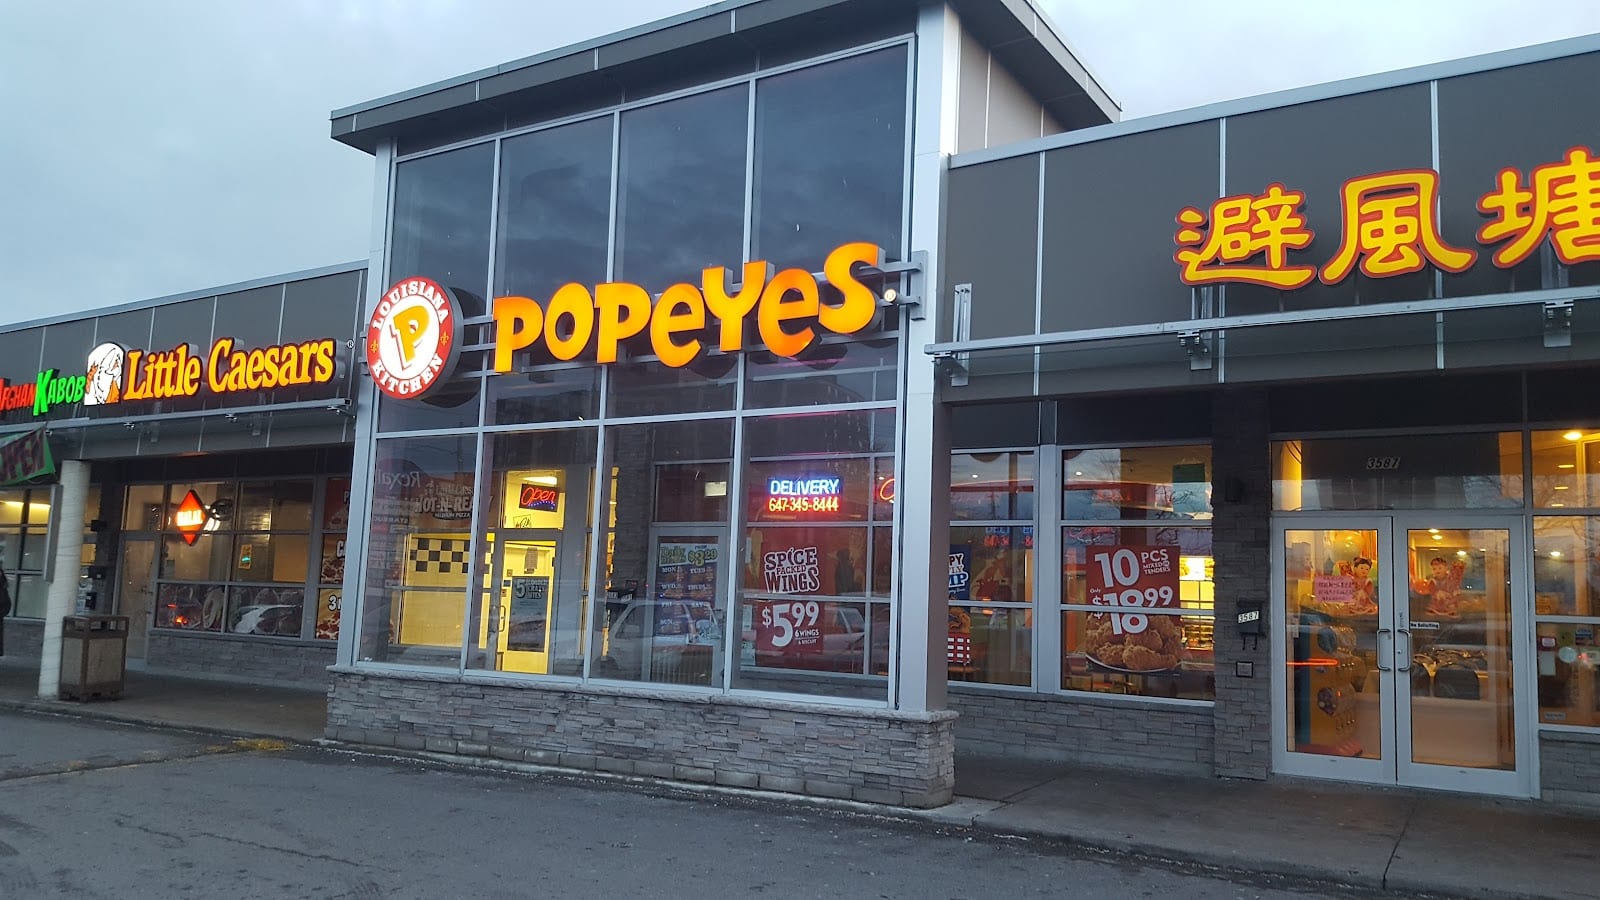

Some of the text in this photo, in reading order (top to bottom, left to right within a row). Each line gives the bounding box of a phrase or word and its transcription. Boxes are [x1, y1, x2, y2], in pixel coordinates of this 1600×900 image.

[372, 280, 449, 331] LOUISIANA
[123, 337, 334, 401] Little Caesars
[371, 353, 443, 395] KITCHEN
[1367, 457, 1400, 470] 3587
[770, 478, 839, 496] DELIVERY
[768, 496, 839, 512] 647-345-8444
[764, 547, 817, 572] SPICE
[1094, 548, 1169, 588] 10 PCS
[1142, 561, 1163, 570] MIXED
[776, 564, 807, 576] PACKED
[1143, 566, 1171, 576] TENDERS
[764, 566, 820, 594] WINGS
[799, 628, 819, 637] WINGS
